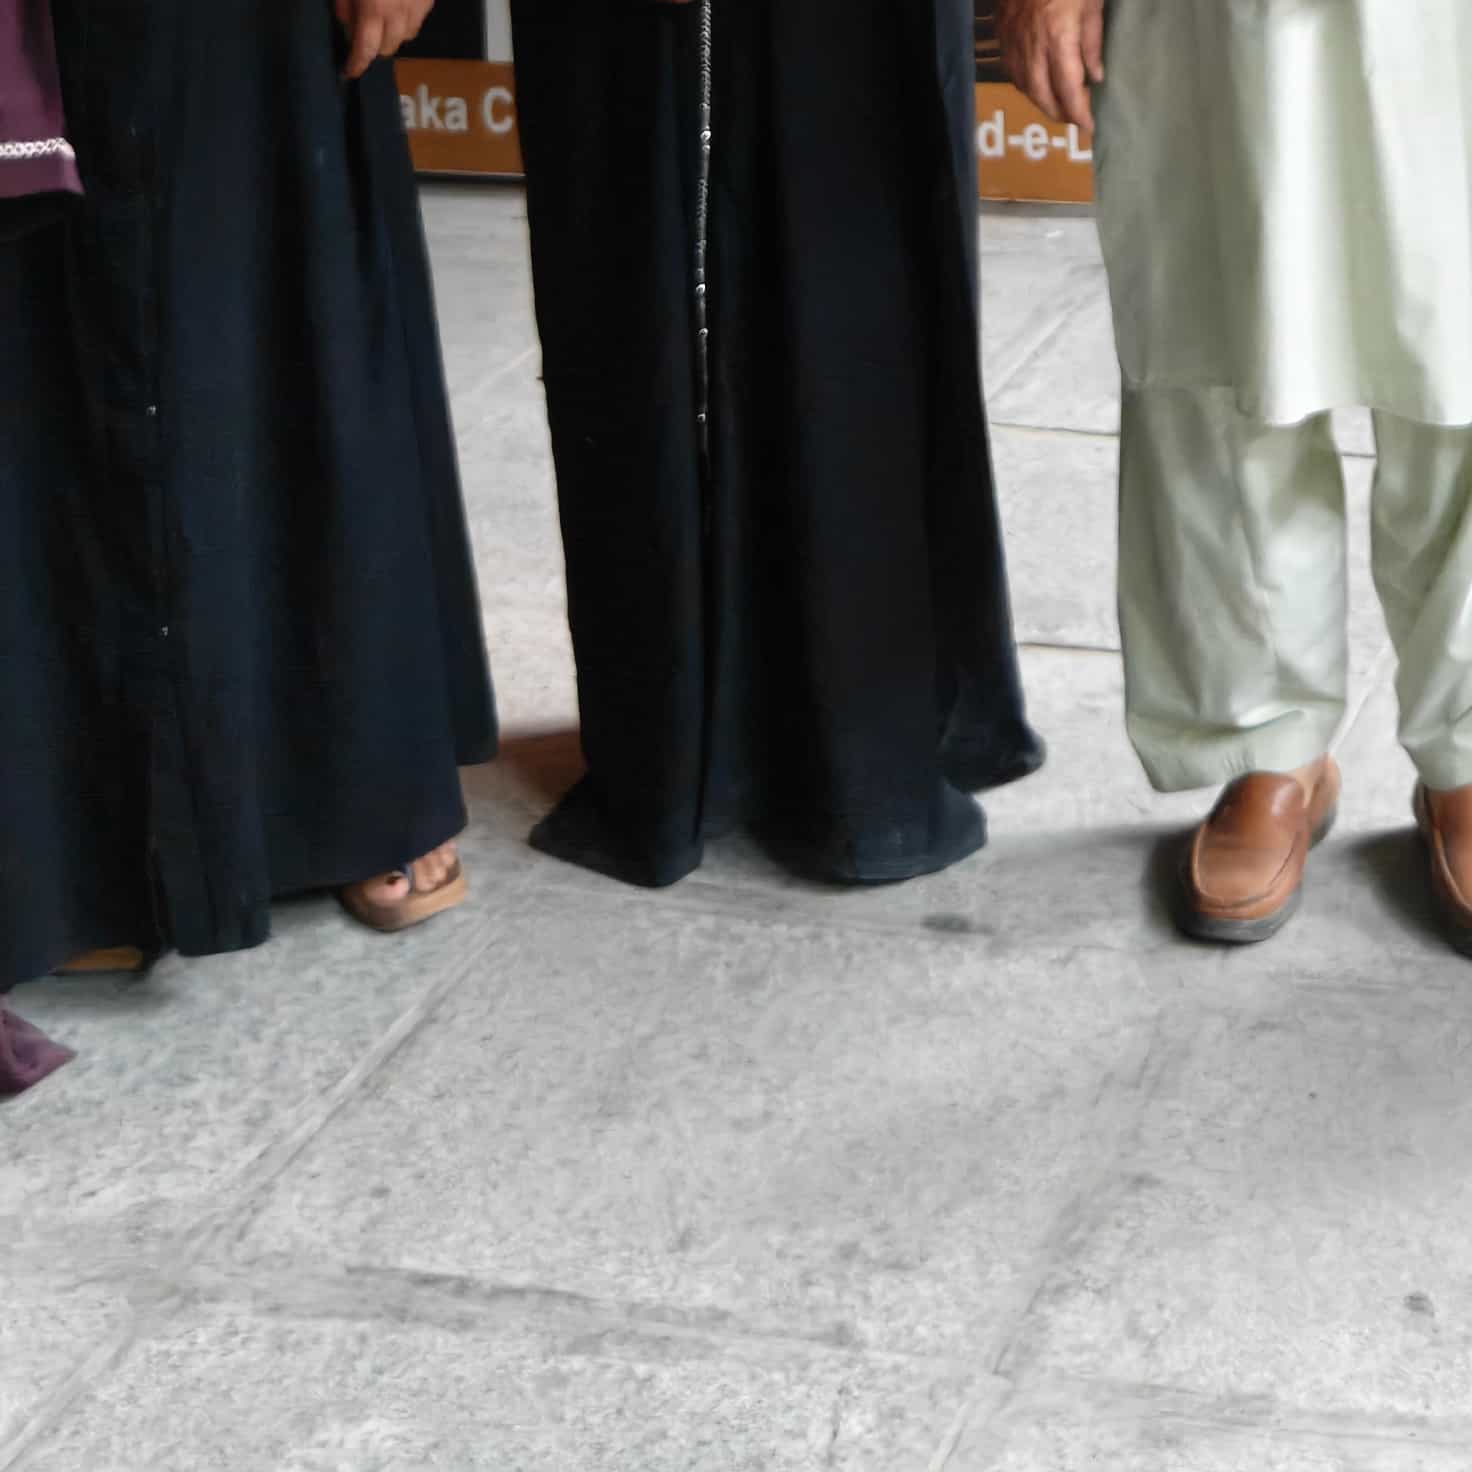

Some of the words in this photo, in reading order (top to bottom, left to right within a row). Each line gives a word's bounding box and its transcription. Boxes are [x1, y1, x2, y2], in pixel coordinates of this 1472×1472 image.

[399, 83, 468, 131] aka
[482, 86, 514, 134] C
[976, 108, 1095, 161] d-e-L
